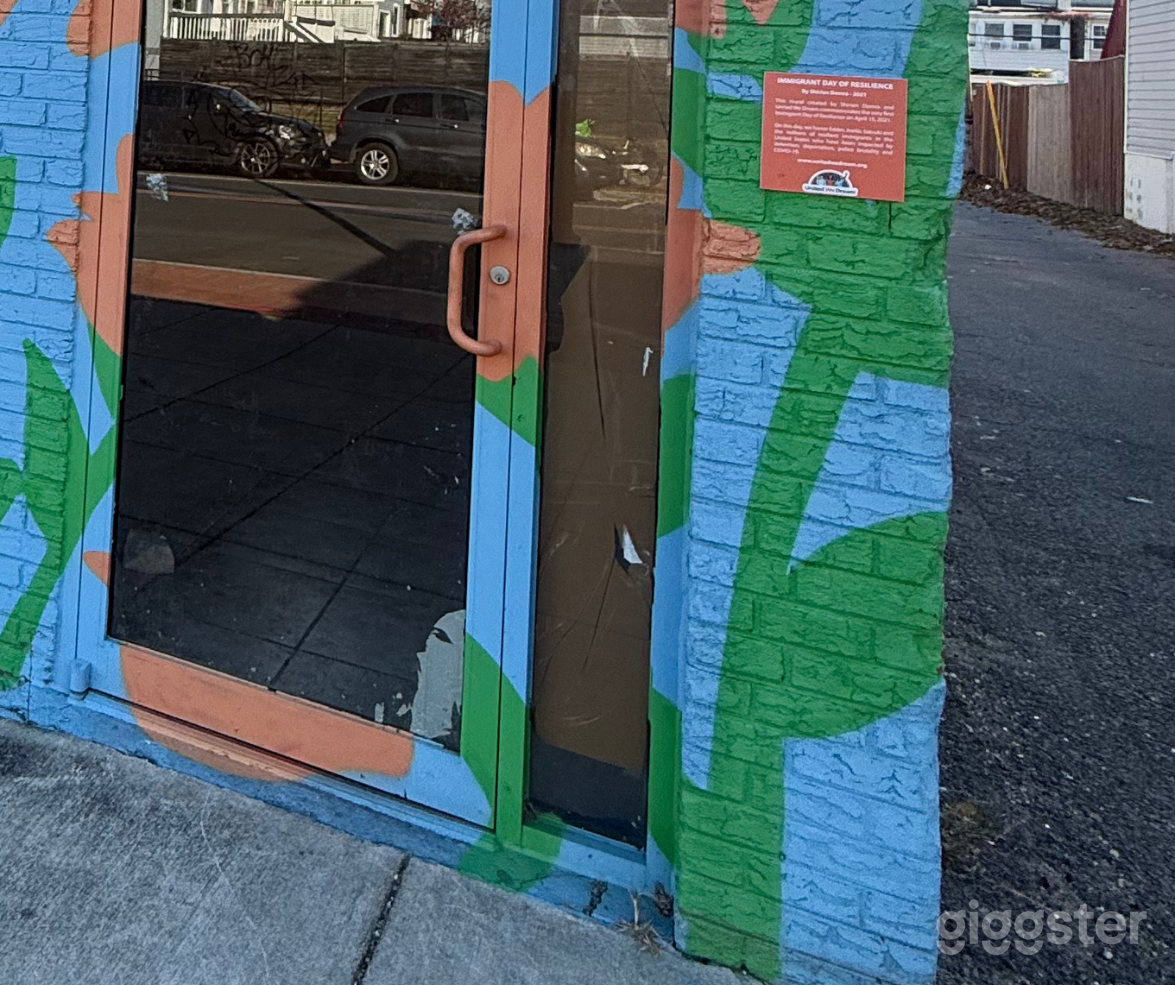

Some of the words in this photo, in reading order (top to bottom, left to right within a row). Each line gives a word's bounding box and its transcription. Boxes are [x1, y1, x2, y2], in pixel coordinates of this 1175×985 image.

[777, 77, 821, 86] IMMIGRANT
[822, 79, 838, 87] DAY
[850, 81, 894, 90] RESILIENCE
